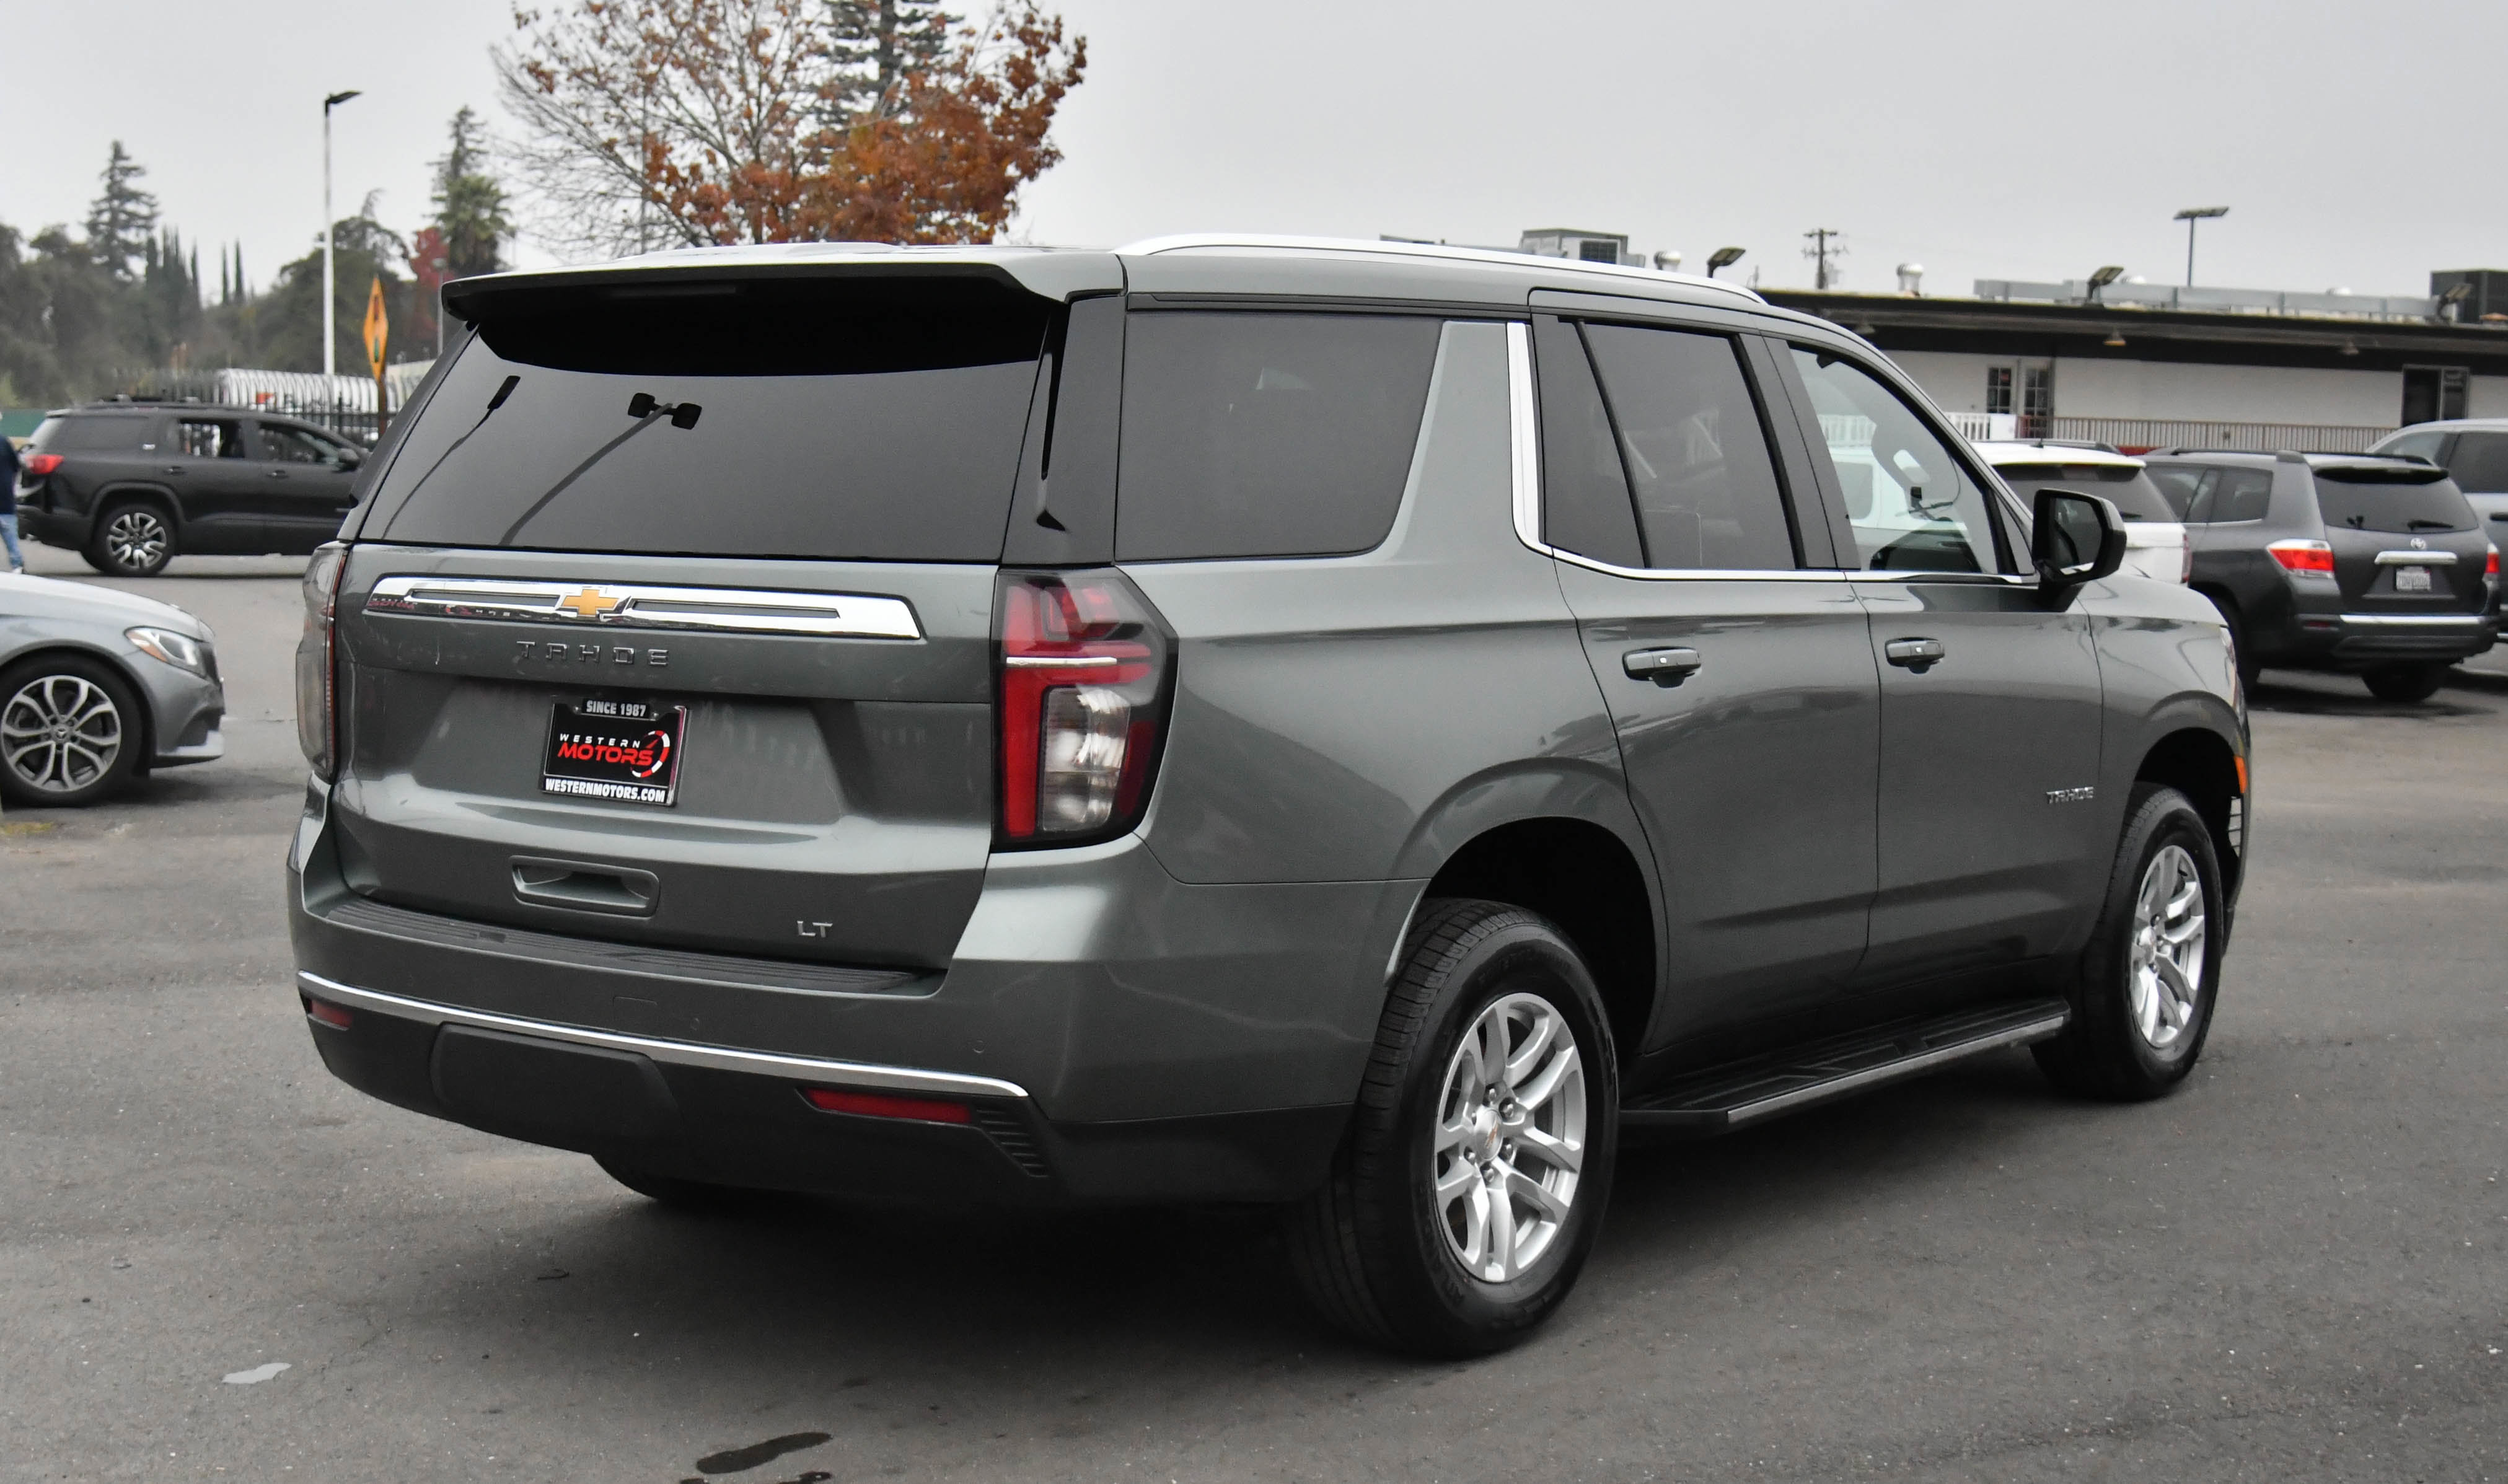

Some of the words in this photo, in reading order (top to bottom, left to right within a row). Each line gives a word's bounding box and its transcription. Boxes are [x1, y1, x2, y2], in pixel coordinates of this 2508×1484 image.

[516, 641, 669, 666] TAHOE
[586, 700, 617, 714] SINCE
[620, 703, 646, 717] 1987
[560, 734, 640, 749] WESTERN
[558, 742, 654, 766] MOTORS
[545, 778, 666, 803] WESTERNMOTORS.COM
[2046, 786, 2093, 804] TAHOE
[796, 920, 833, 937] LT
